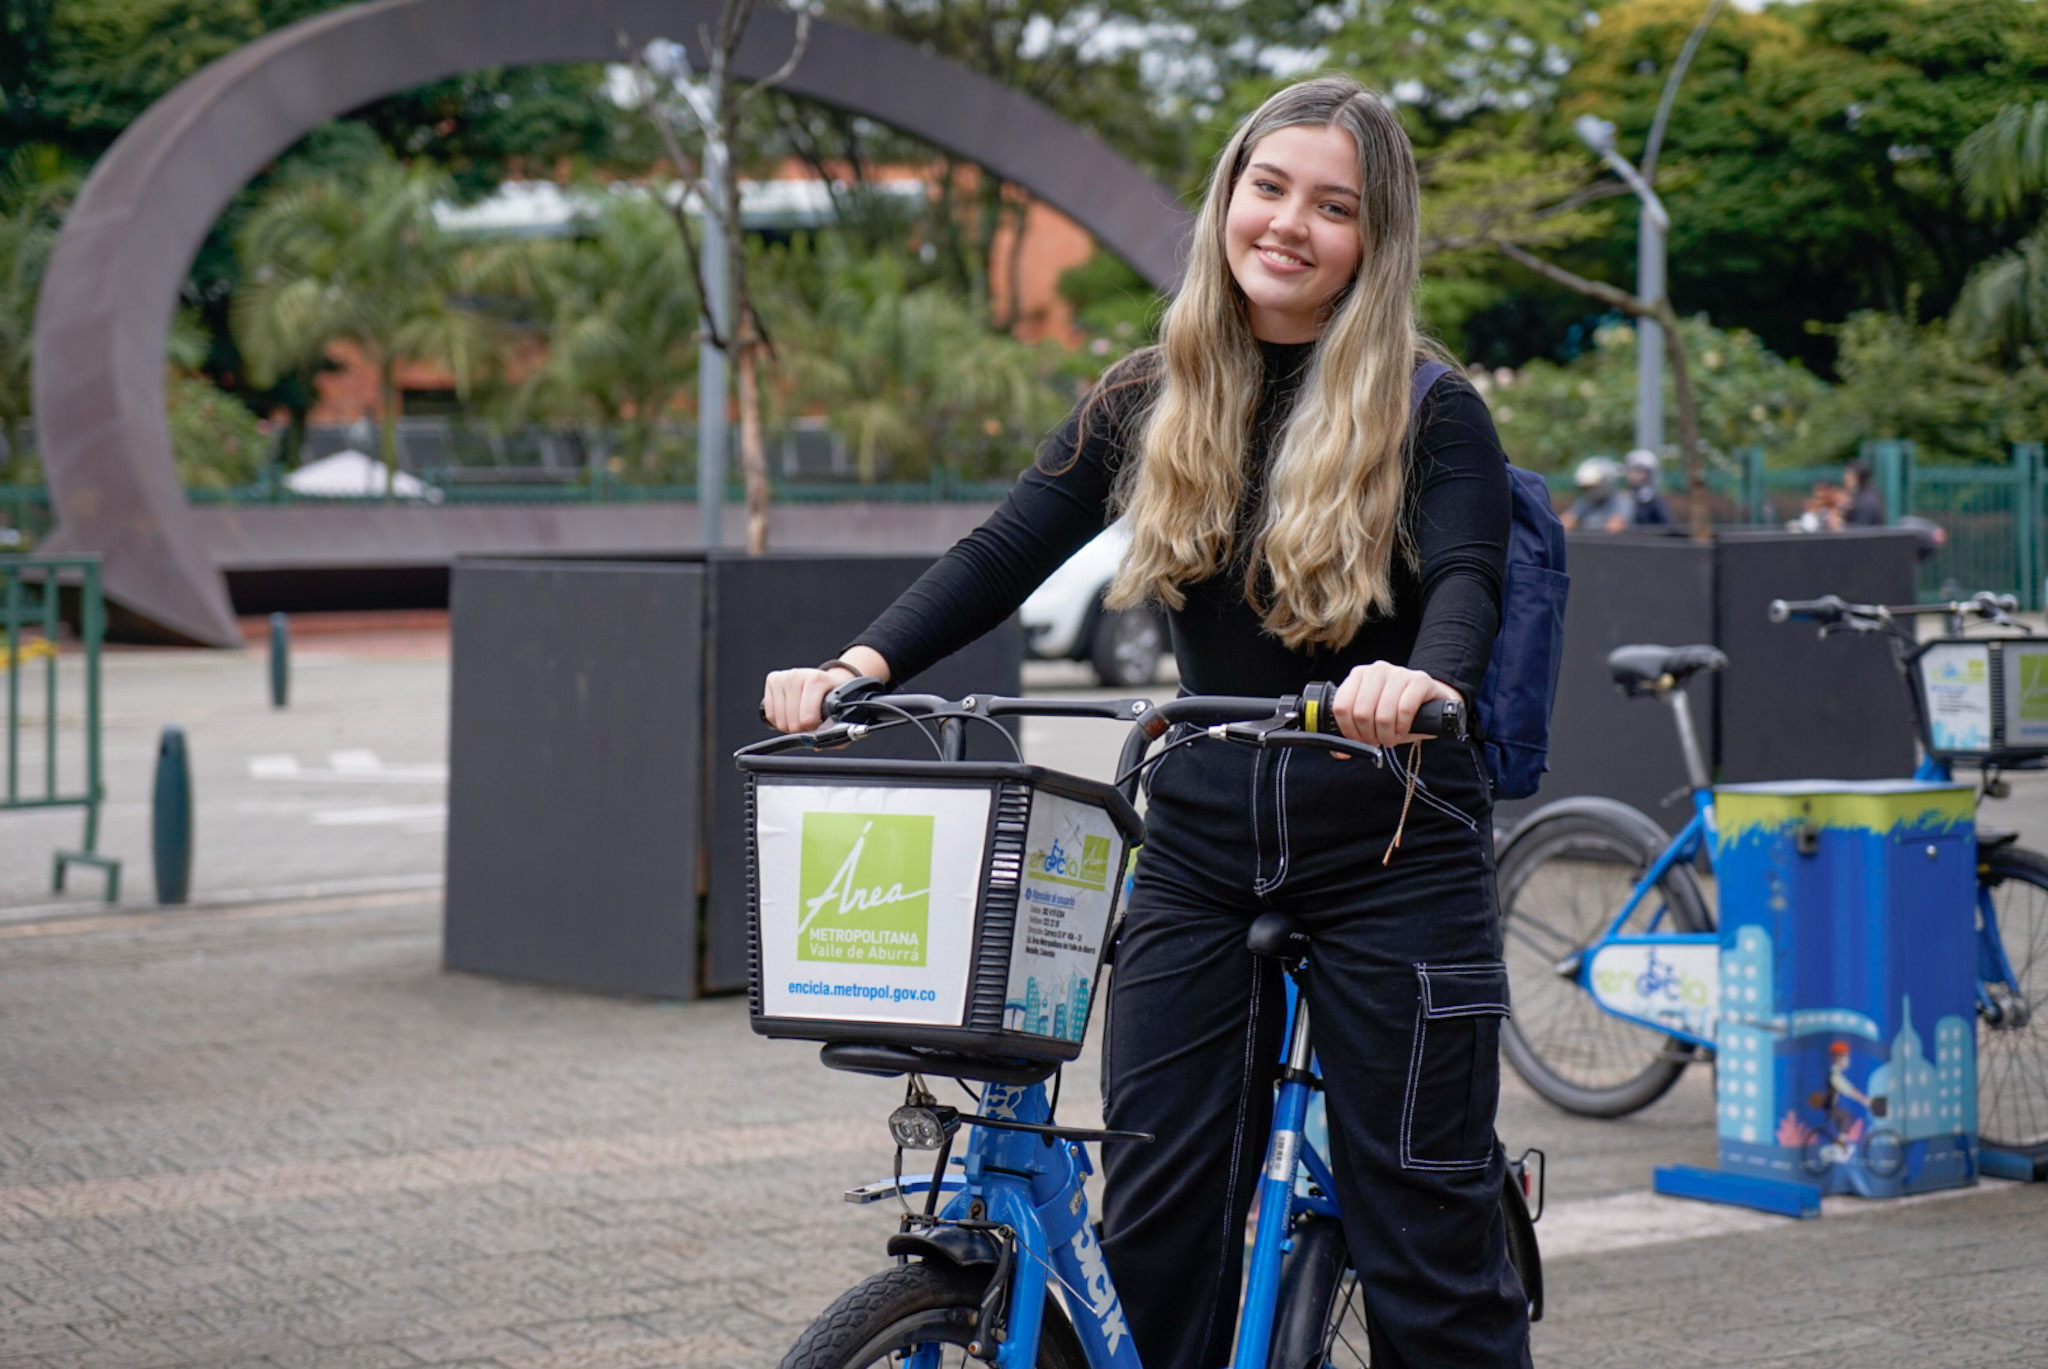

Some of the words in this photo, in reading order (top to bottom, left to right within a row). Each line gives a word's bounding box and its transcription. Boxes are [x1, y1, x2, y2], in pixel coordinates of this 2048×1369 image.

[797, 821, 931, 935] Área
[809, 928, 919, 946] METROPOLITANA
[809, 943, 843, 958] Valle
[847, 944, 863, 959] de
[868, 946, 919, 962] Aburrá
[788, 980, 936, 1002] encicla.metropol.gov.co
